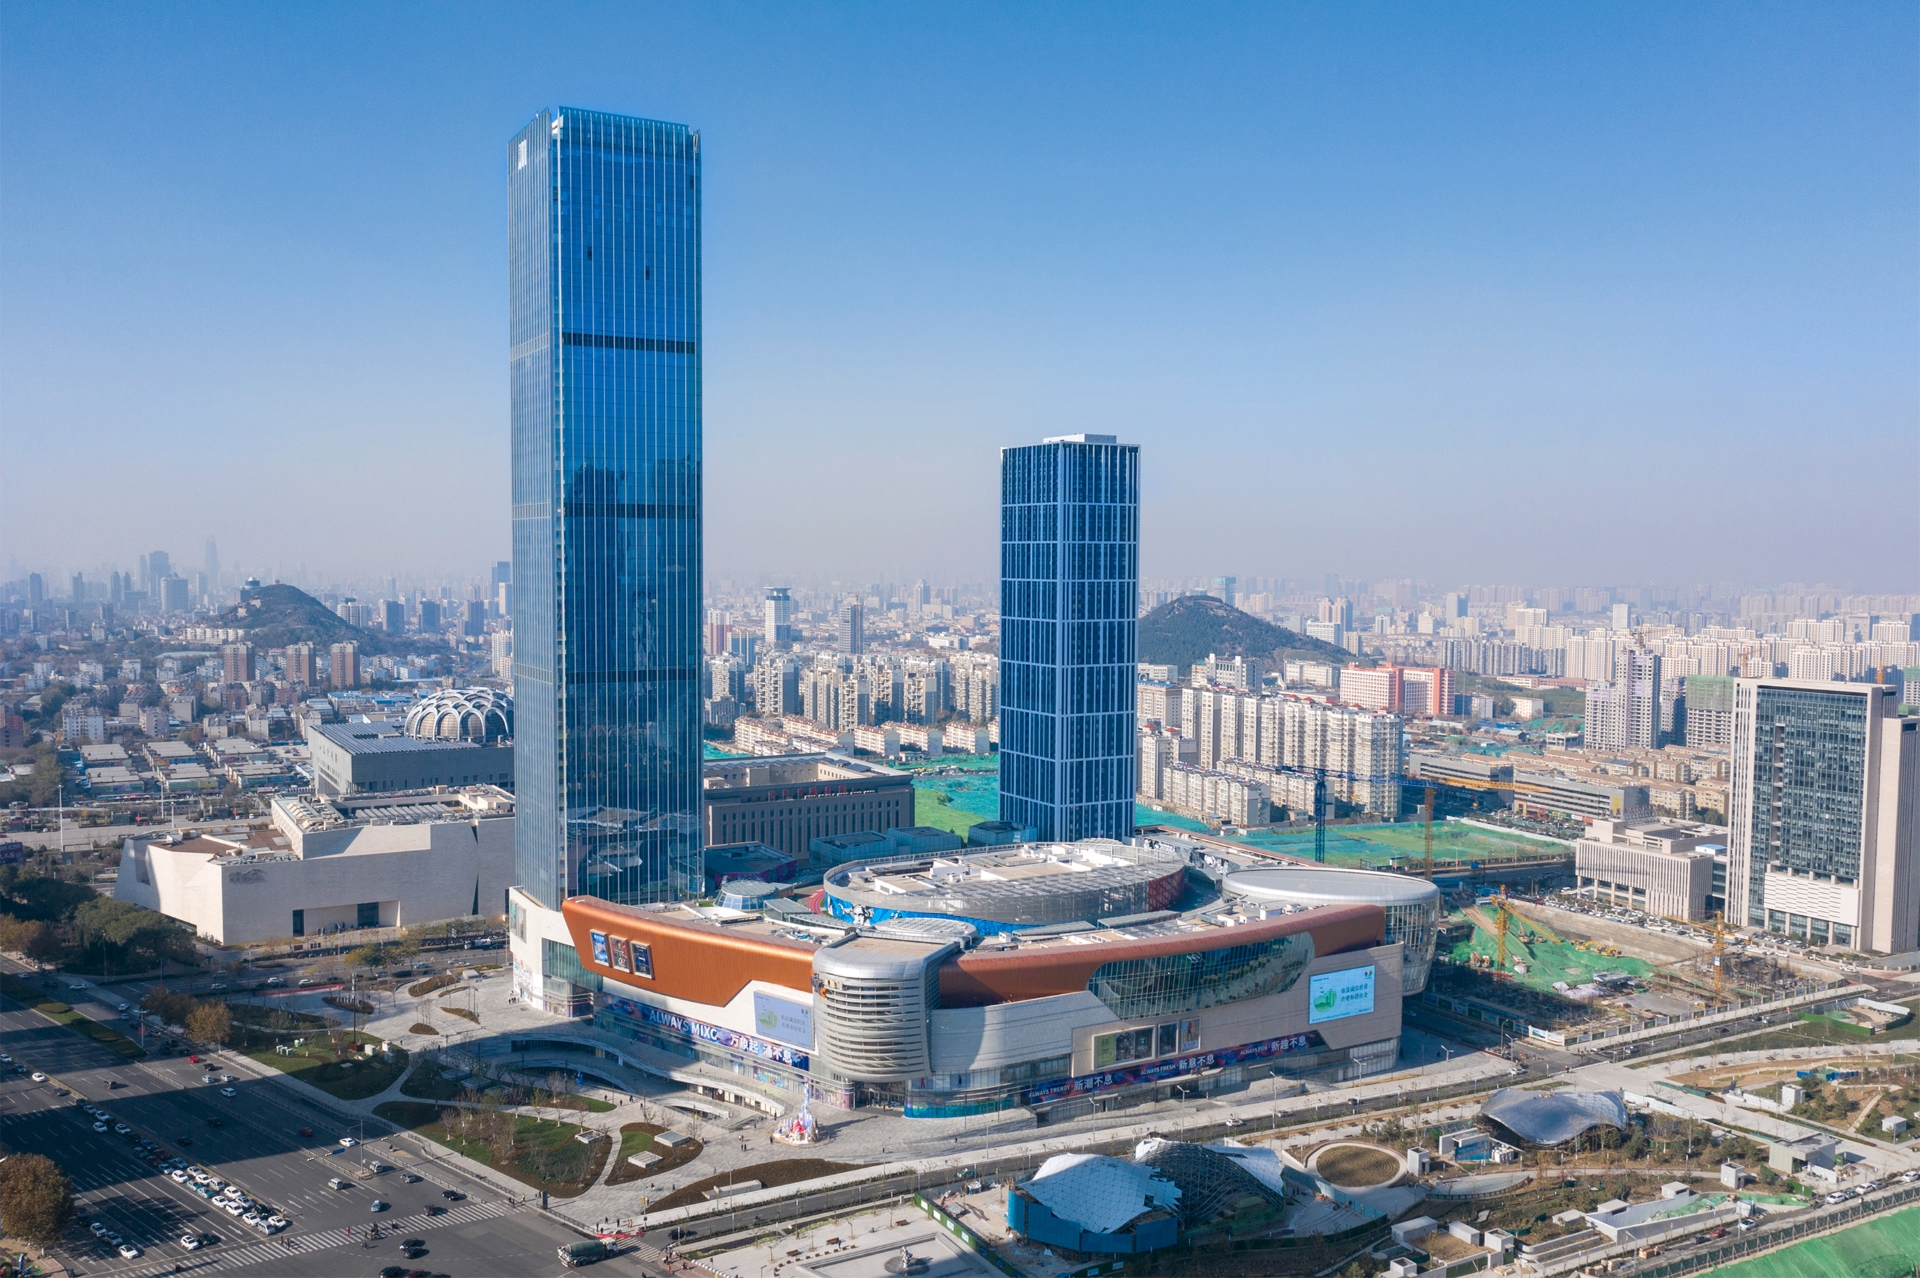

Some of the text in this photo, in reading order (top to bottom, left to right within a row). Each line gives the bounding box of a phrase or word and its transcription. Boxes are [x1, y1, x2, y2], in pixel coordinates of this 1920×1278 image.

[649, 1010, 718, 1041] ALWAYS MIXC
[1271, 1036, 1307, 1052] 新趣不息
[1140, 1068, 1160, 1076] ALWAYS
[1160, 1064, 1176, 1073] FRESH
[1178, 1053, 1215, 1071] 新意不息
[1028, 1074, 1113, 1098] ALWAYS TRENDY 新潮不息
